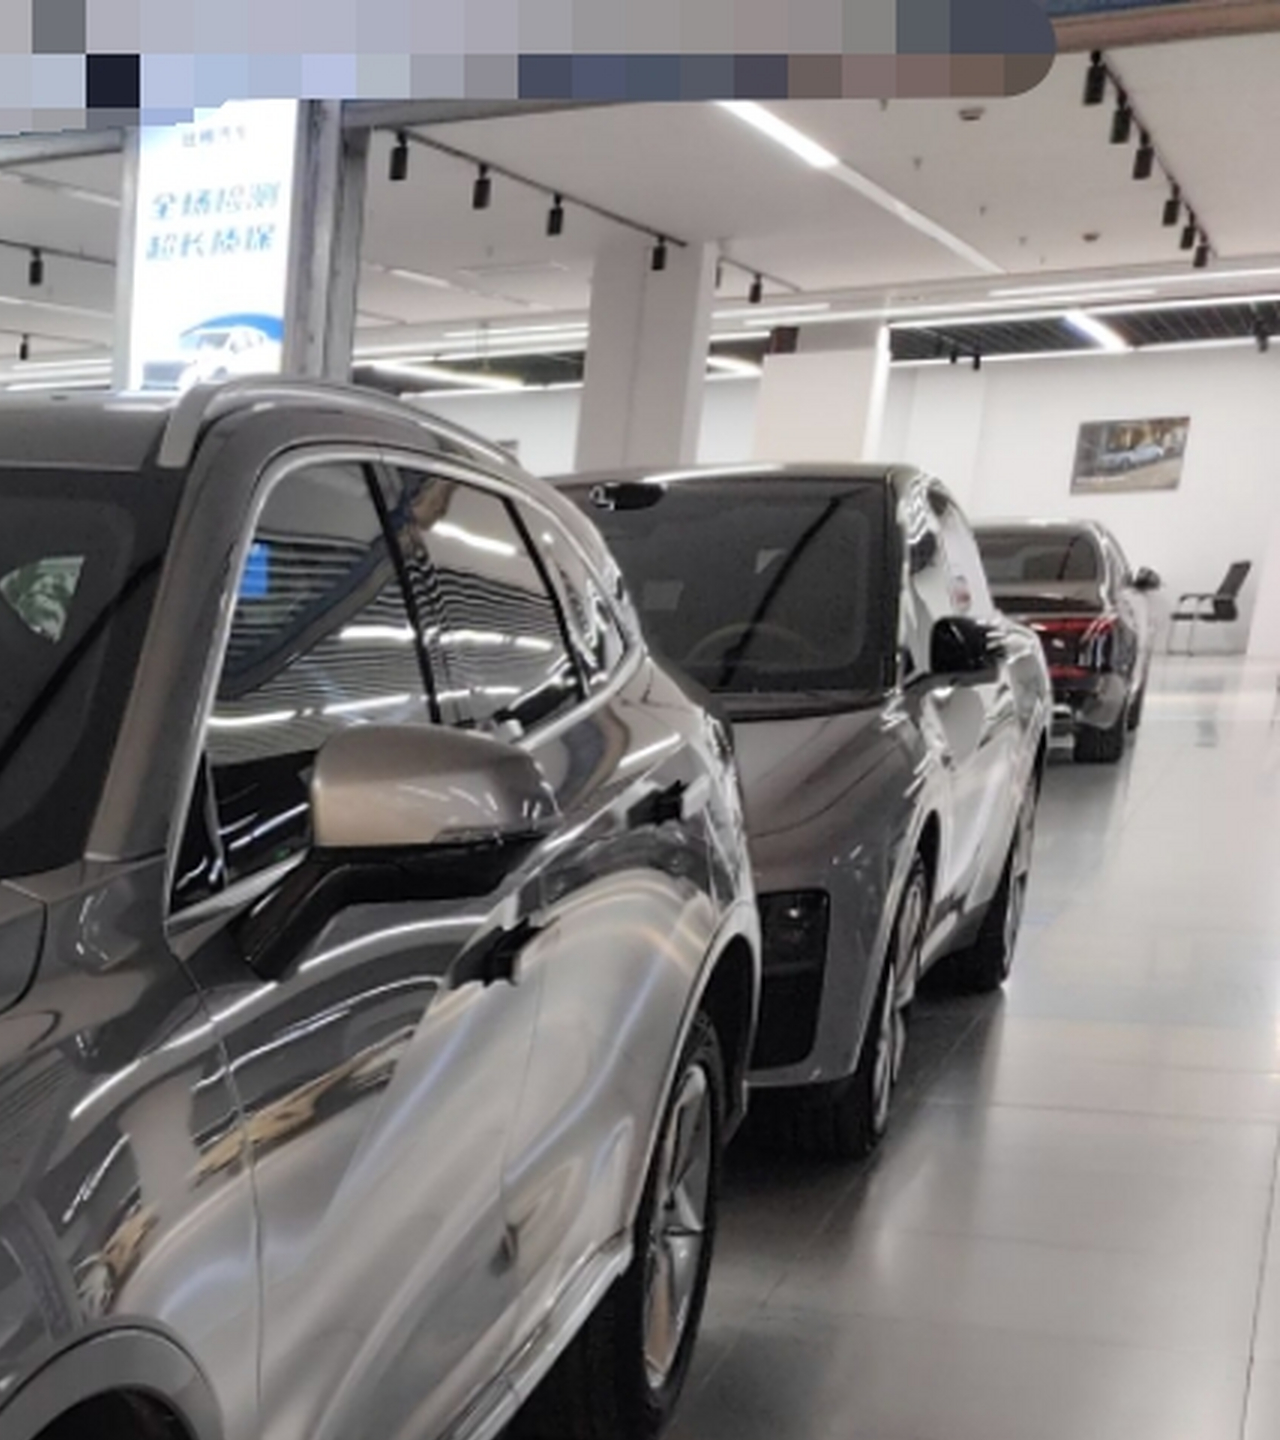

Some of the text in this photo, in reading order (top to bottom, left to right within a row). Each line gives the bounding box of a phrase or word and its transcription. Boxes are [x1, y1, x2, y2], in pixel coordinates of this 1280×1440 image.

[152, 181, 282, 220] 全场检测
[145, 223, 276, 261] 超长质保
